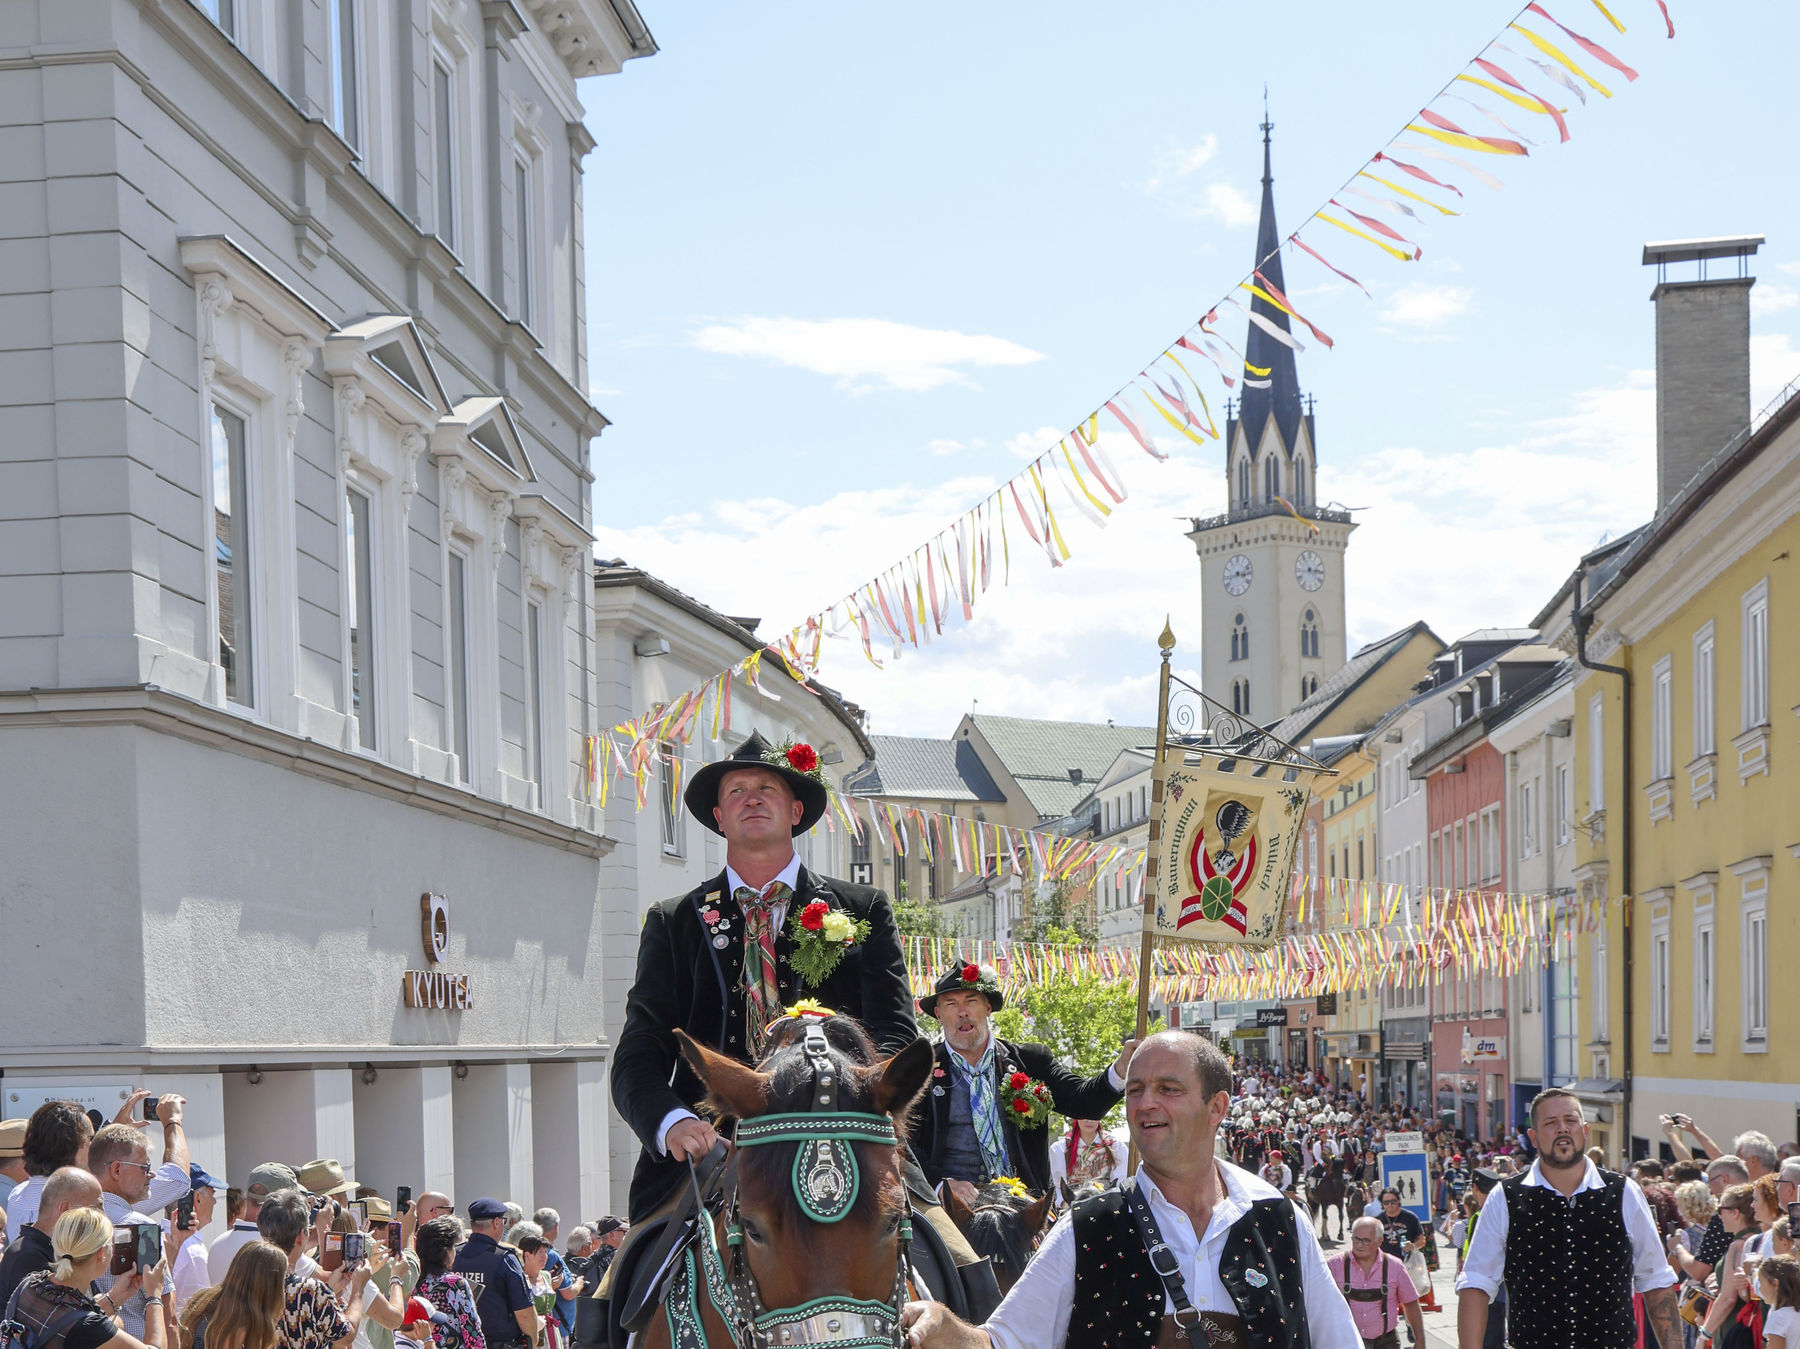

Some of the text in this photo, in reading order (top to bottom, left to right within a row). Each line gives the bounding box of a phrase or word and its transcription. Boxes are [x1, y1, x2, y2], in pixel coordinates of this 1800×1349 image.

[854, 865, 870, 883] H
[1259, 833, 1280, 890] Villach
[410, 970, 473, 1010] KYUTEA
[1477, 1040, 1496, 1051] dm
